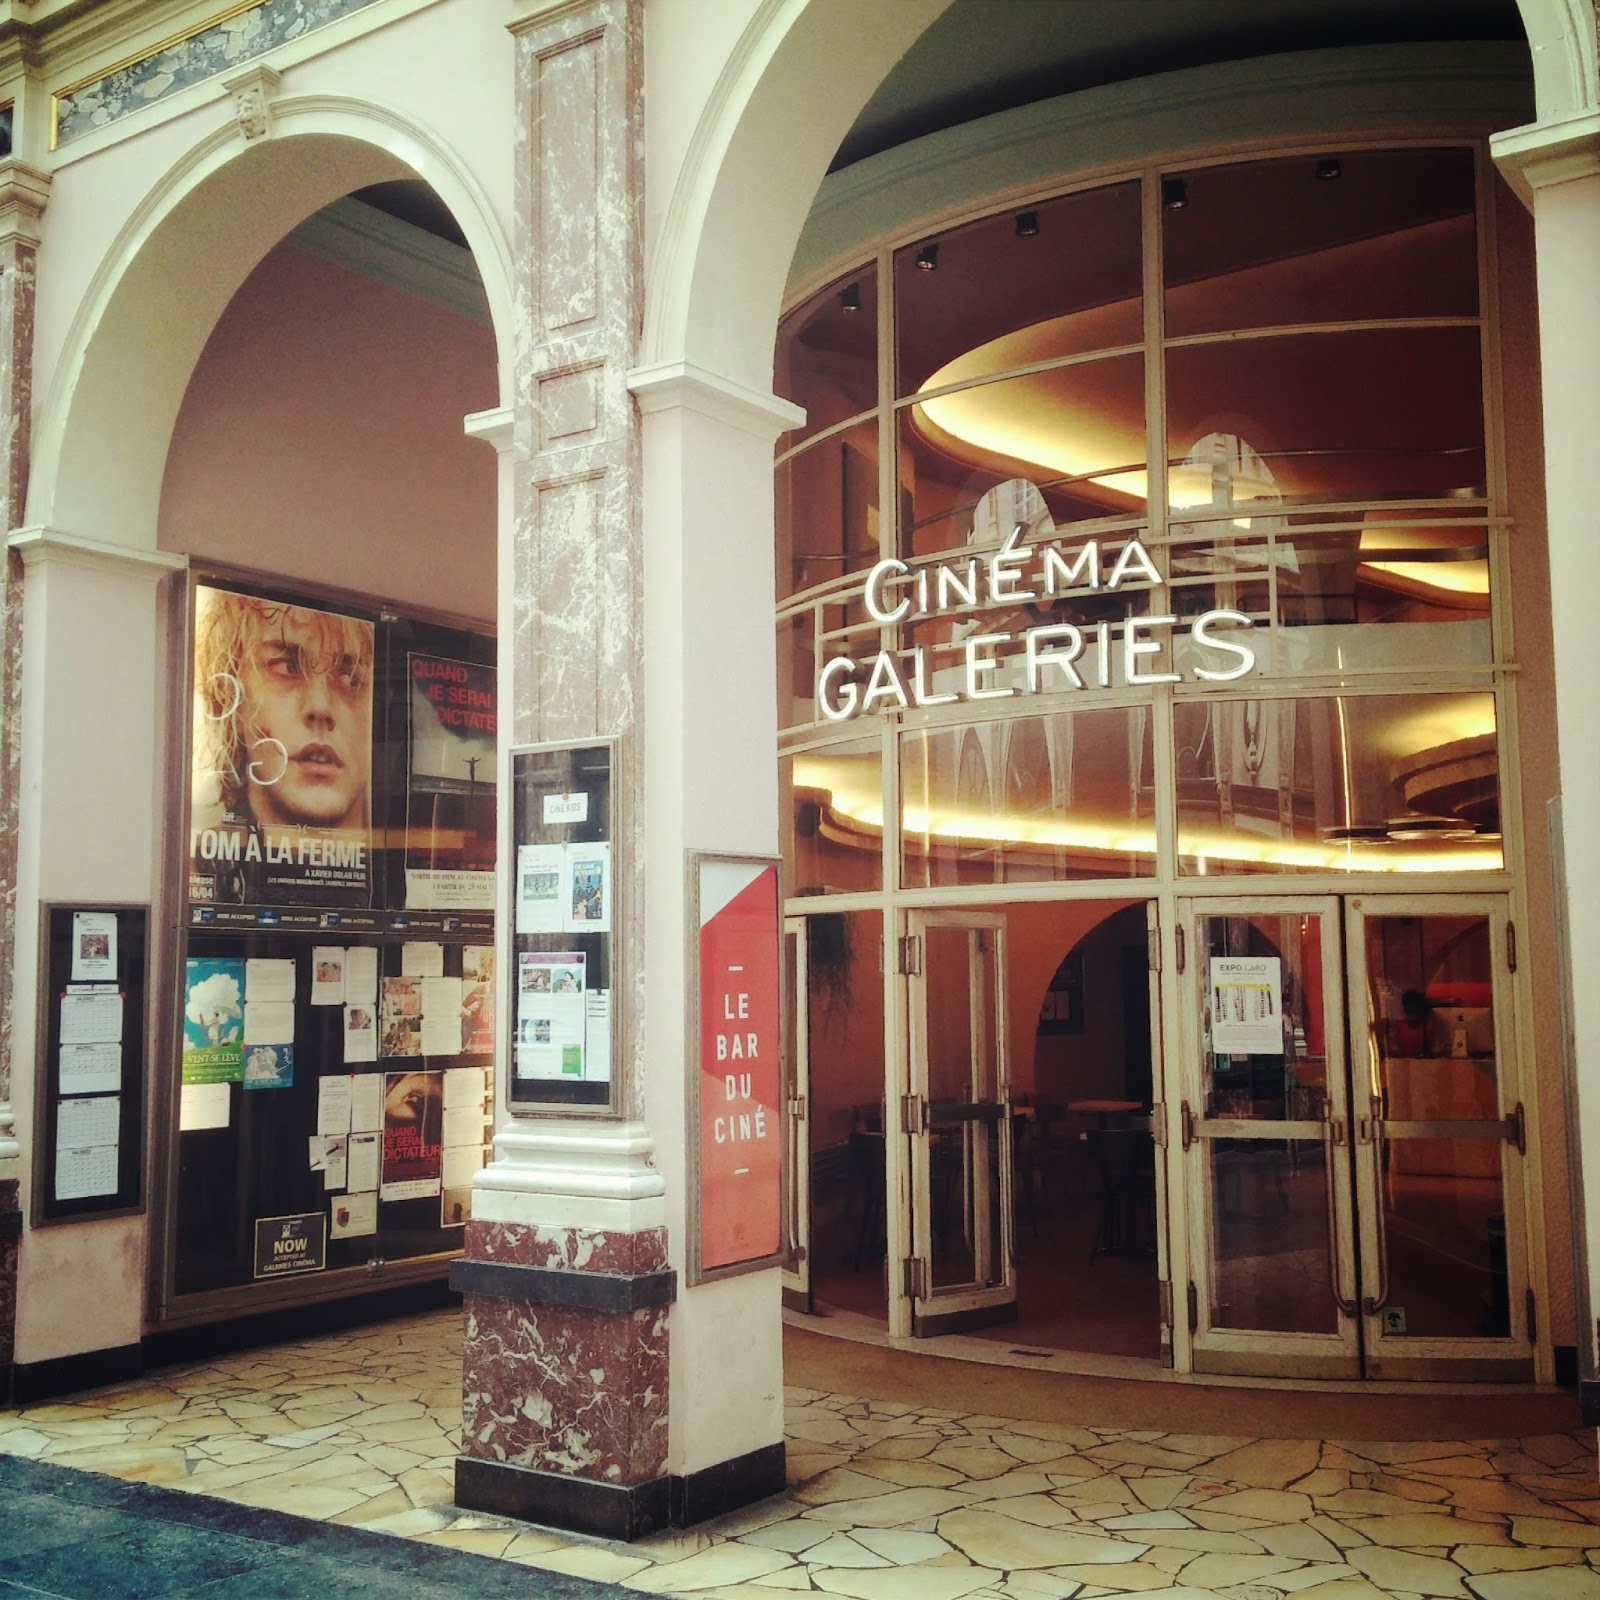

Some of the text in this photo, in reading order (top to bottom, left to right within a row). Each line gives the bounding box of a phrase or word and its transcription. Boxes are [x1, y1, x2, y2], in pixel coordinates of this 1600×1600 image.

[865, 522, 1164, 623] CINÉMA
[411, 659, 468, 684] QUAND
[818, 608, 1256, 721] GALERIES
[427, 683, 493, 708] JE SERAI
[435, 706, 496, 730] DICTATE
[566, 801, 582, 812] KIDS
[245, 825, 263, 863] À
[266, 835, 294, 865] LA
[298, 837, 367, 870] FERME
[311, 869, 333, 880] XAVIER
[333, 870, 353, 881] DOLAN
[353, 872, 367, 881] FILM
[1219, 963, 1243, 972] EXPO
[724, 992, 749, 1020] LE
[188, 1053, 210, 1064] VENT
[716, 1033, 759, 1061] BAR
[725, 1073, 752, 1101] DU
[385, 1126, 416, 1138] QUAND
[714, 1104, 766, 1144] CINÉ
[383, 1144, 441, 1161] DICTATEUR
[273, 1238, 308, 1254] NOW
[274, 1253, 299, 1261] ACCEPTED
[263, 1261, 291, 1271] GALERIES
